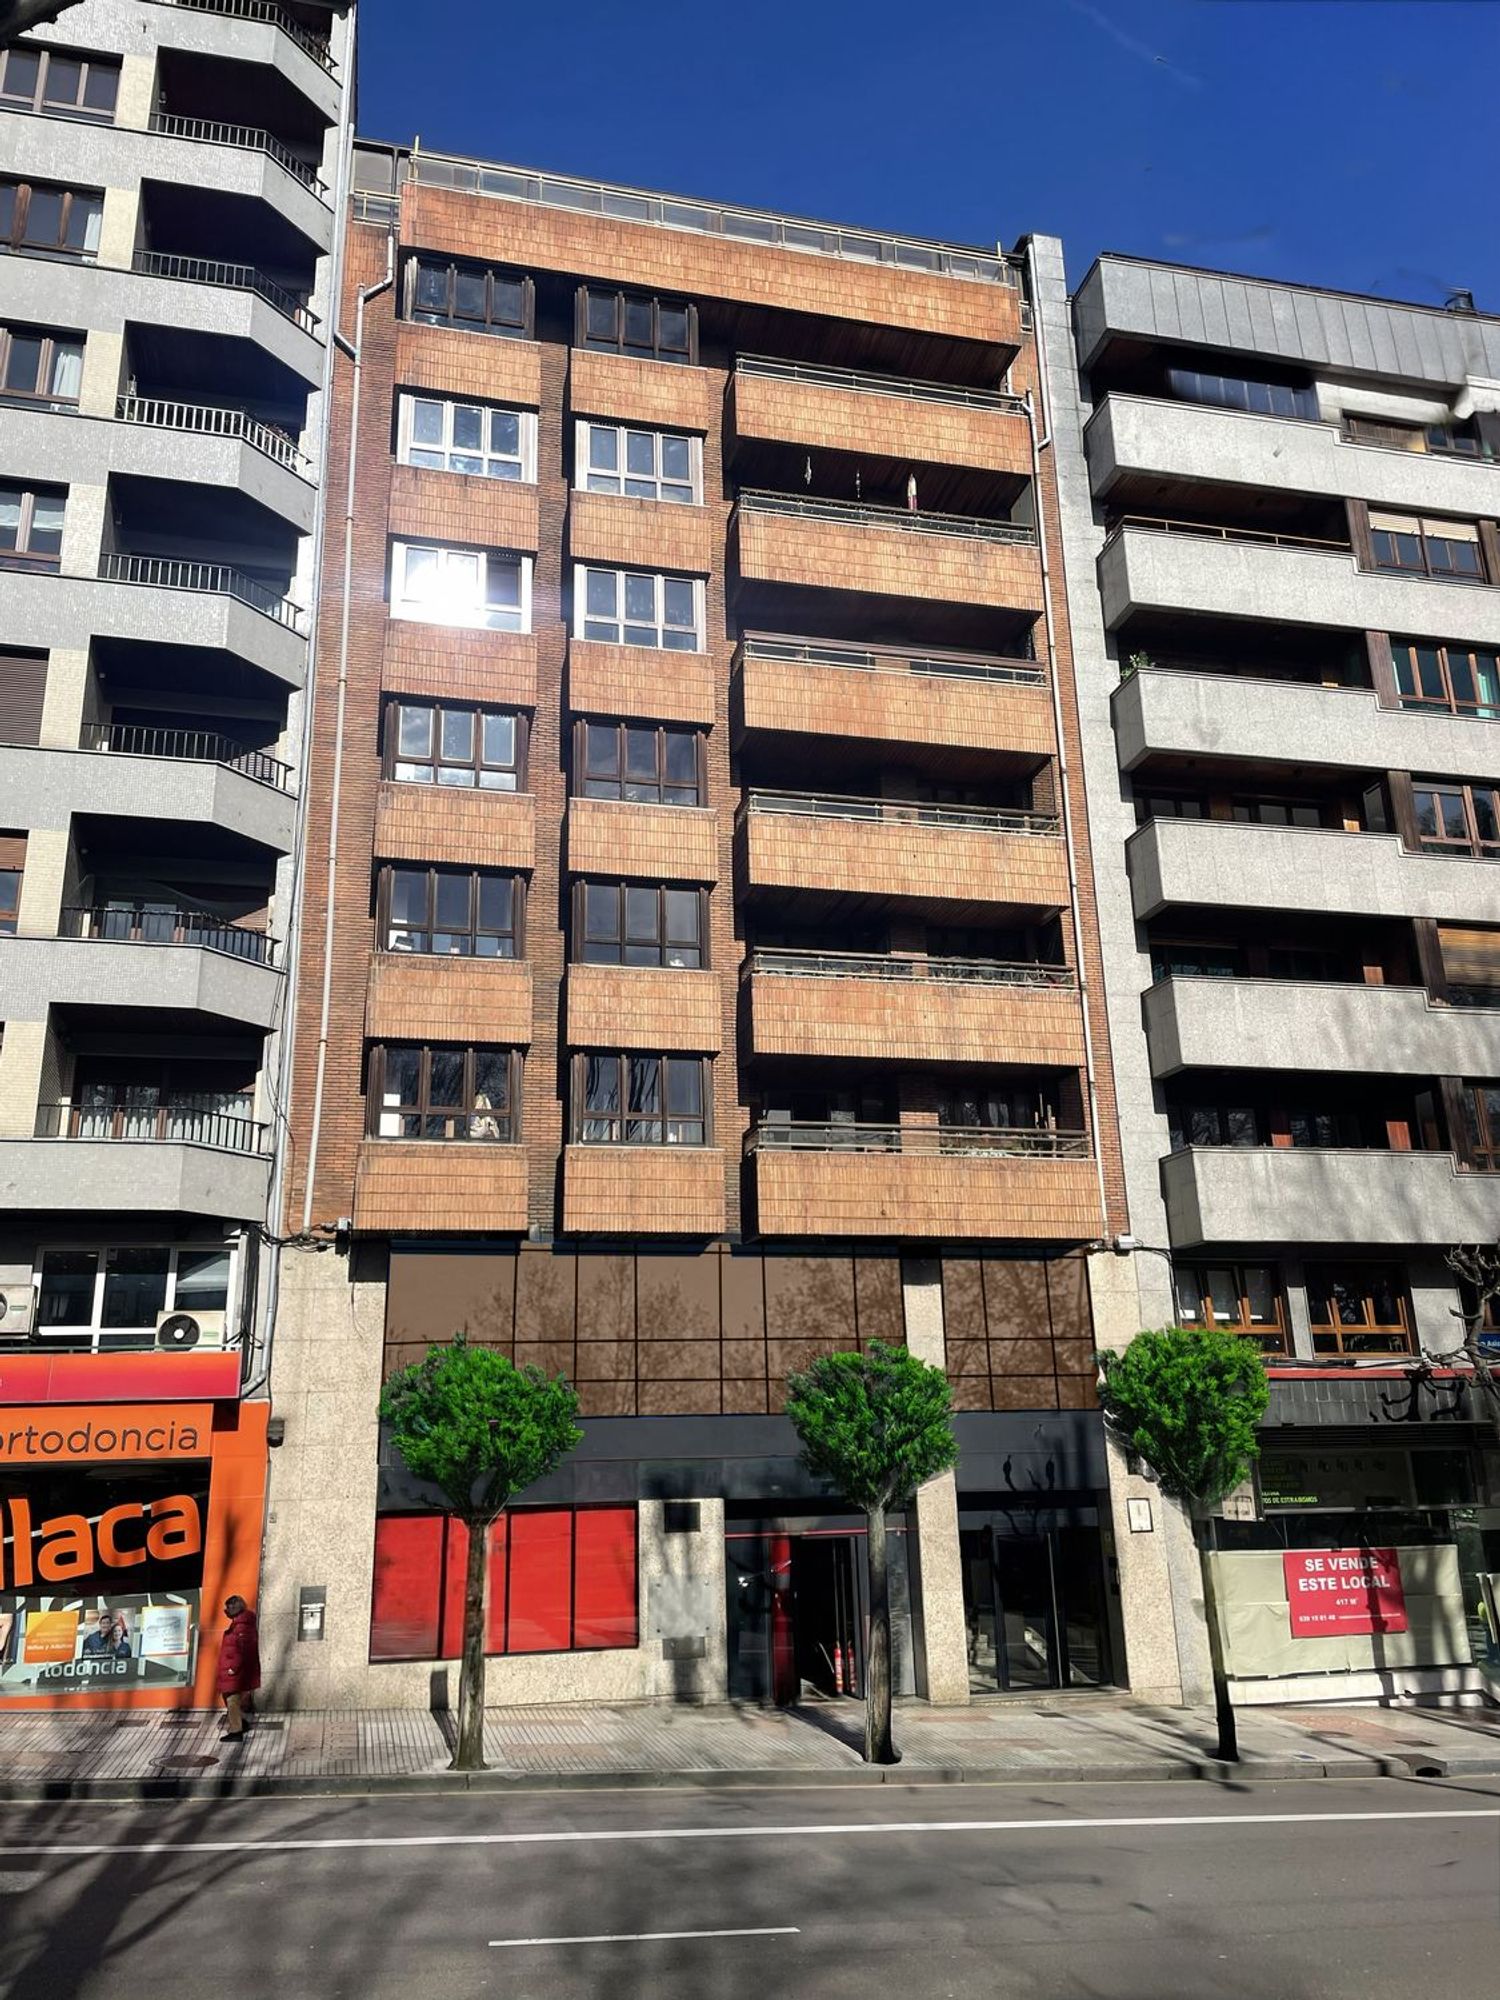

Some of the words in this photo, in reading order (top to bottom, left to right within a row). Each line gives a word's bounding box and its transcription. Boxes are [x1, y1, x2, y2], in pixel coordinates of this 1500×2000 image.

[0, 1421, 197, 1455] rtodoncia
[0, 1494, 200, 1590] laca
[1305, 1558, 1324, 1572] SE
[1328, 1557, 1379, 1571] VENDE
[1298, 1577, 1338, 1592] ESTE
[1341, 1575, 1390, 1589] LOCAL
